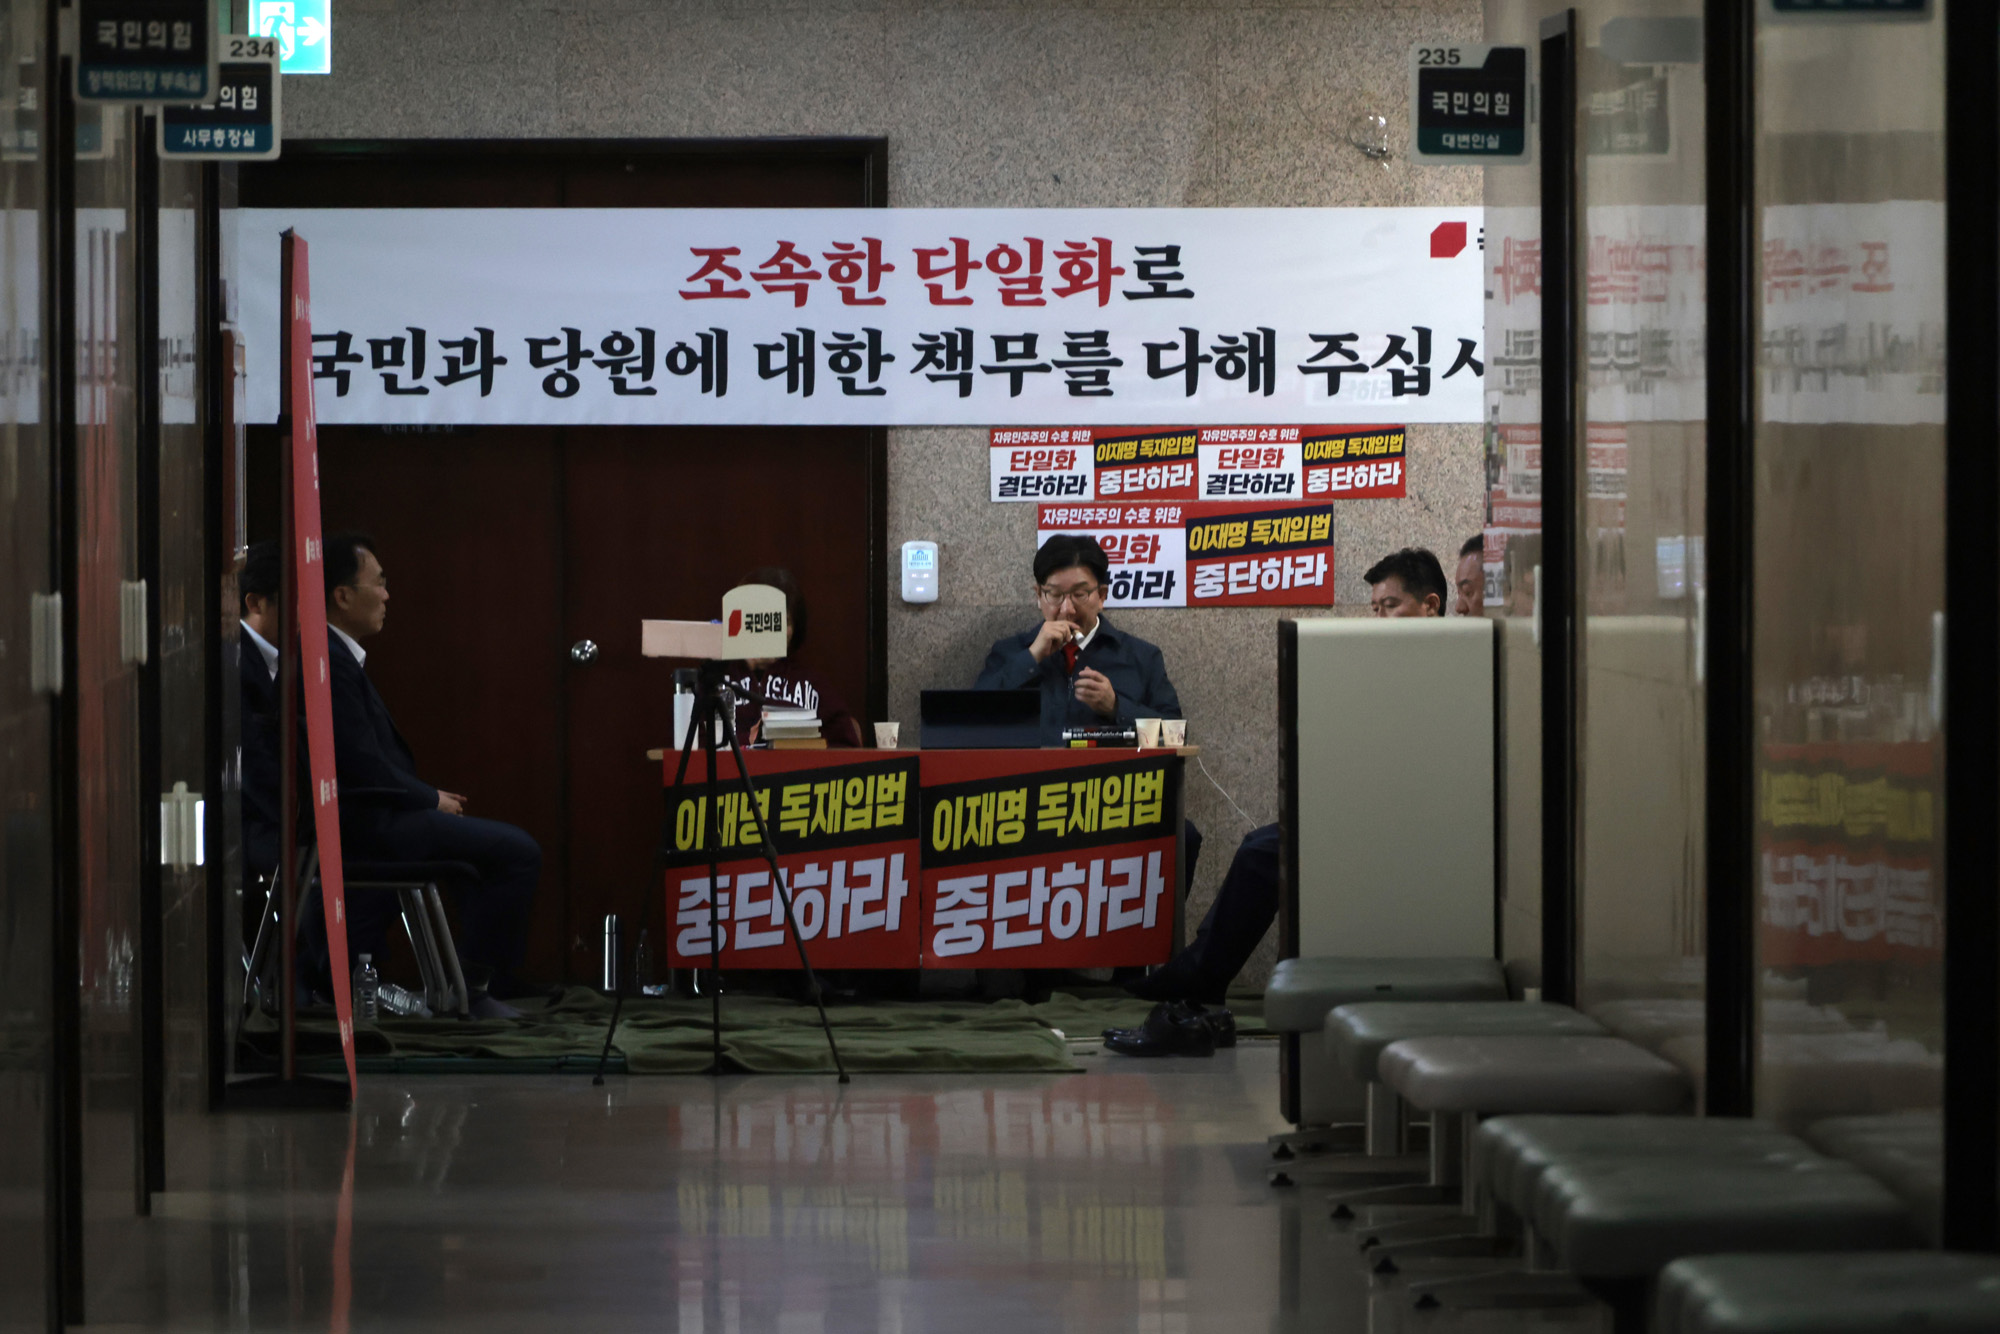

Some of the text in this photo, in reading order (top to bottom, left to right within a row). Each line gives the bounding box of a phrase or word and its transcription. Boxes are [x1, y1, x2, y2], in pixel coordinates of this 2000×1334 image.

[97, 21, 191, 48] 국민의힘
[230, 40, 275, 58] 234
[1418, 48, 1461, 65] 235
[1432, 91, 1510, 115] 국민의힘
[183, 129, 256, 147] 사무총장실
[1442, 133, 1500, 149] 대변인실
[678, 236, 1195, 307] 조속한 단일화로
[310, 326, 507, 397] 국민과
[524, 326, 729, 398] 당원에
[753, 326, 896, 397] 대한
[909, 326, 1123, 398] 책무를
[1141, 326, 1276, 397] 다해
[993, 430, 1091, 444] 자유민주주의 수호 위한
[1096, 435, 1196, 462] 이재명 독재입법
[1201, 428, 1299, 442] 자유민주주의 수호 위한
[1304, 433, 1404, 460] 이재명 독재입법
[1010, 449, 1077, 472] 단일화
[1217, 447, 1285, 470] 단일화
[998, 474, 1087, 498] 결단하라
[1099, 463, 1194, 495] 중단하라
[1206, 472, 1295, 495] 결단하라
[1307, 461, 1401, 494] 중단하라
[1042, 506, 1182, 526] 자유민주주의 수호 위한
[1189, 513, 1332, 551] 이재명 독재입법
[1090, 533, 1161, 565] 일화
[1103, 569, 1176, 601] 하라
[1193, 553, 1328, 599] 중단하라
[745, 611, 782, 633] 국민의힘
[765, 673, 820, 711] ISLAND
[675, 770, 908, 852] 이재명 독재입법
[932, 768, 1165, 852] 이재명 독재입법
[675, 853, 908, 959] 중단하라
[932, 850, 1165, 958] 중단하라
